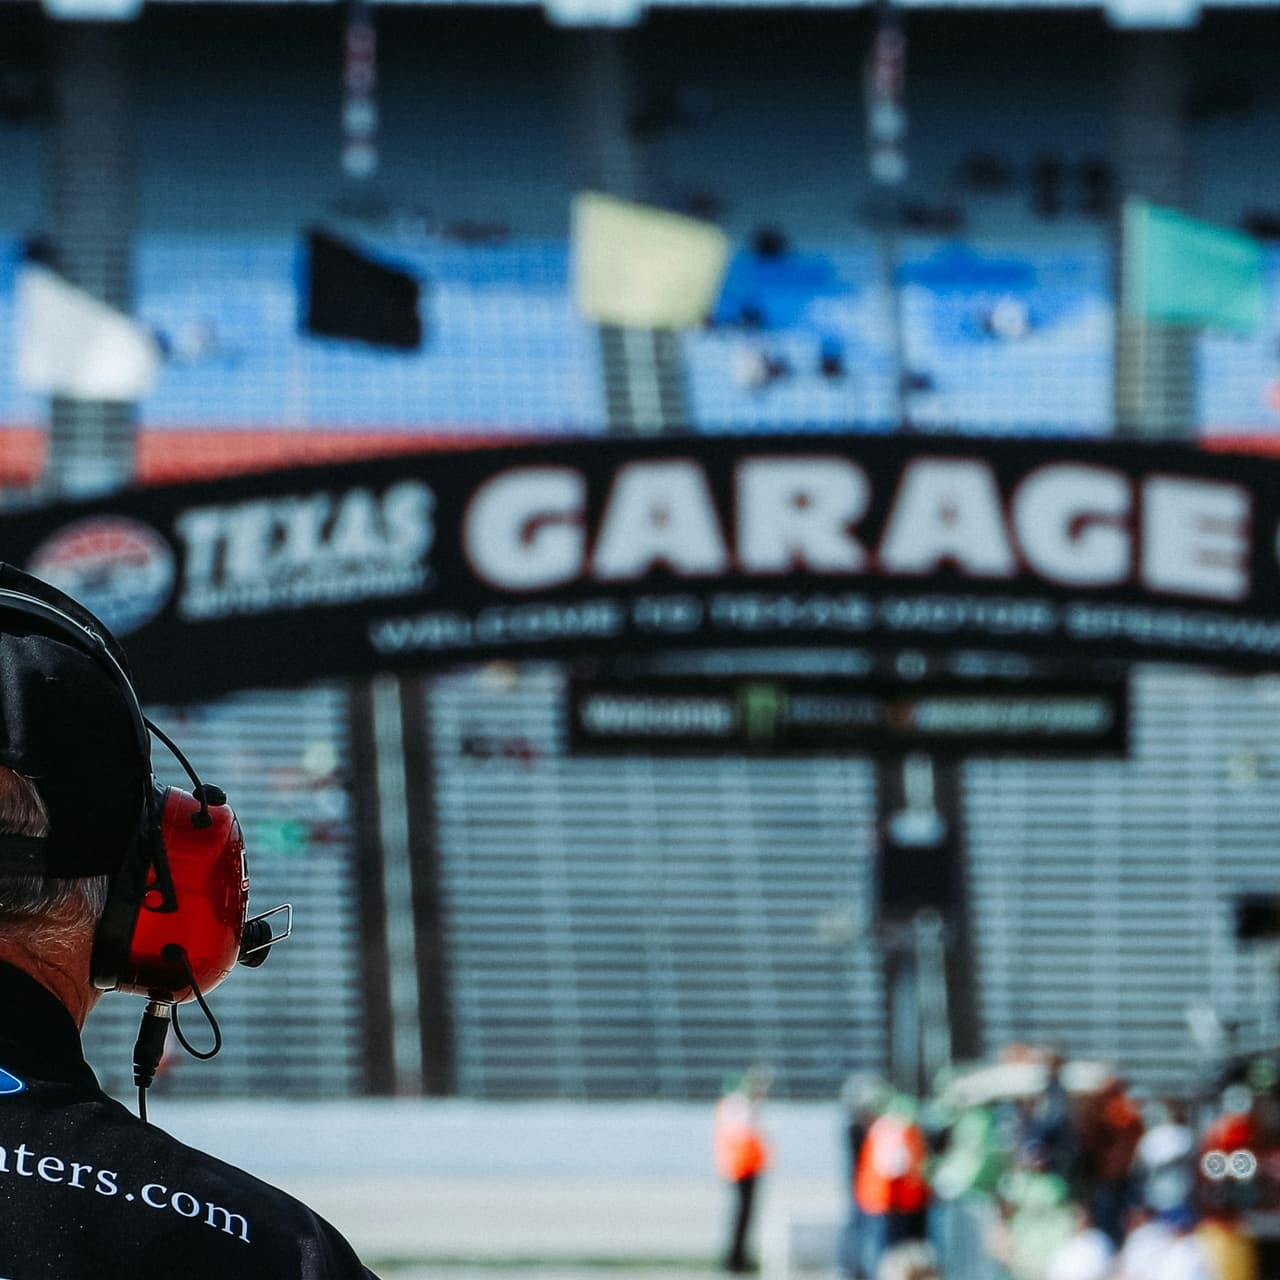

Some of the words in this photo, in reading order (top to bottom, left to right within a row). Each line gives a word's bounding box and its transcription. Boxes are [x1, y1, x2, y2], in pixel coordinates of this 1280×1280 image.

[177, 481, 433, 590] TEXAS
[467, 459, 1248, 598] GARAGE
[370, 602, 620, 653] WELCOME
[631, 594, 703, 634] TO
